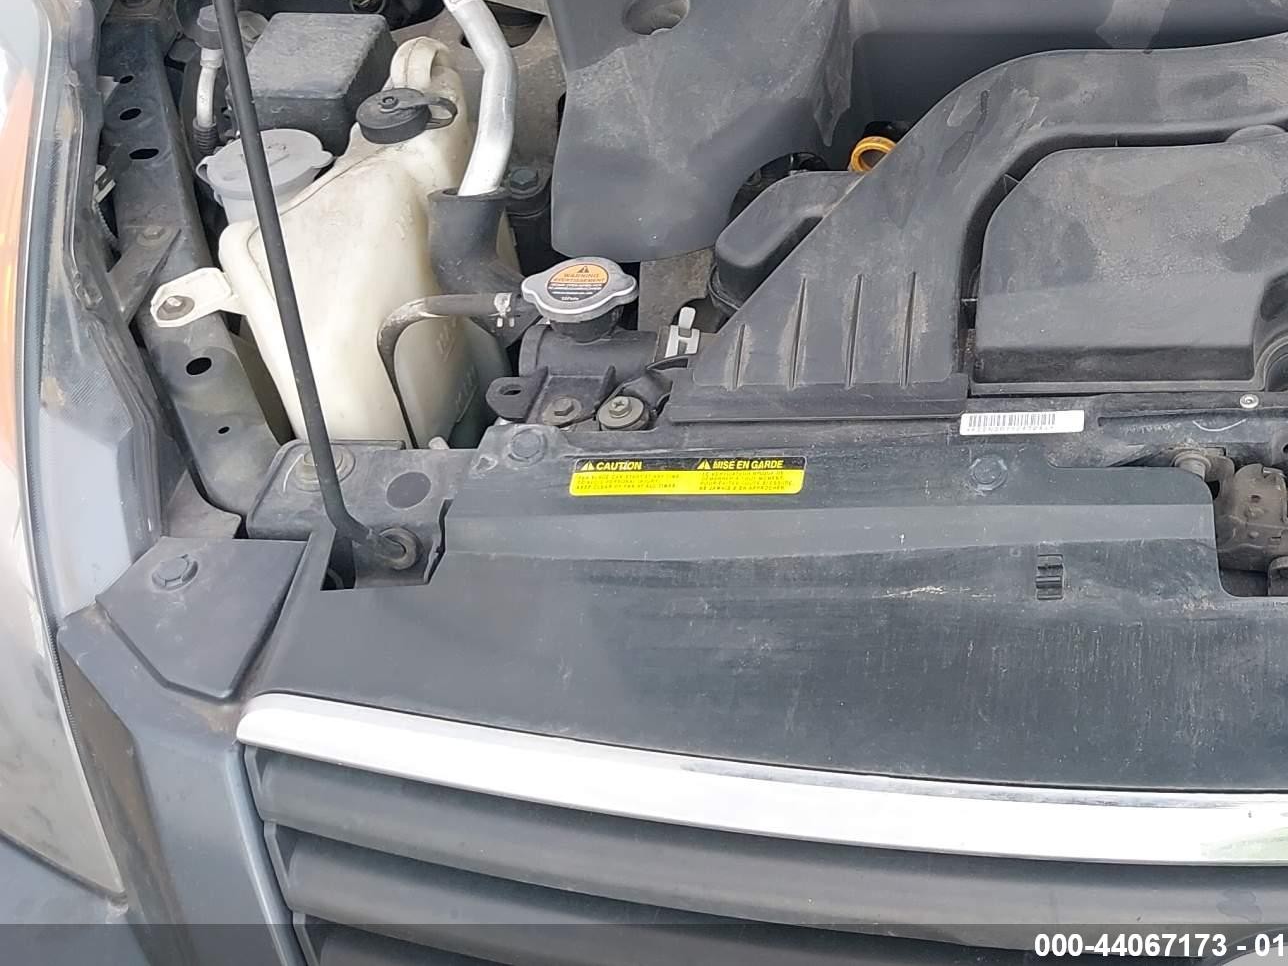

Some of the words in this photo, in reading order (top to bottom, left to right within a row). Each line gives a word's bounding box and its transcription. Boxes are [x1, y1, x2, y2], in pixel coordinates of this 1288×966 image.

[596, 461, 642, 471] CAUTION
[712, 461, 737, 470] MISE
[737, 460, 751, 470] EN
[751, 459, 784, 469] GARDE
